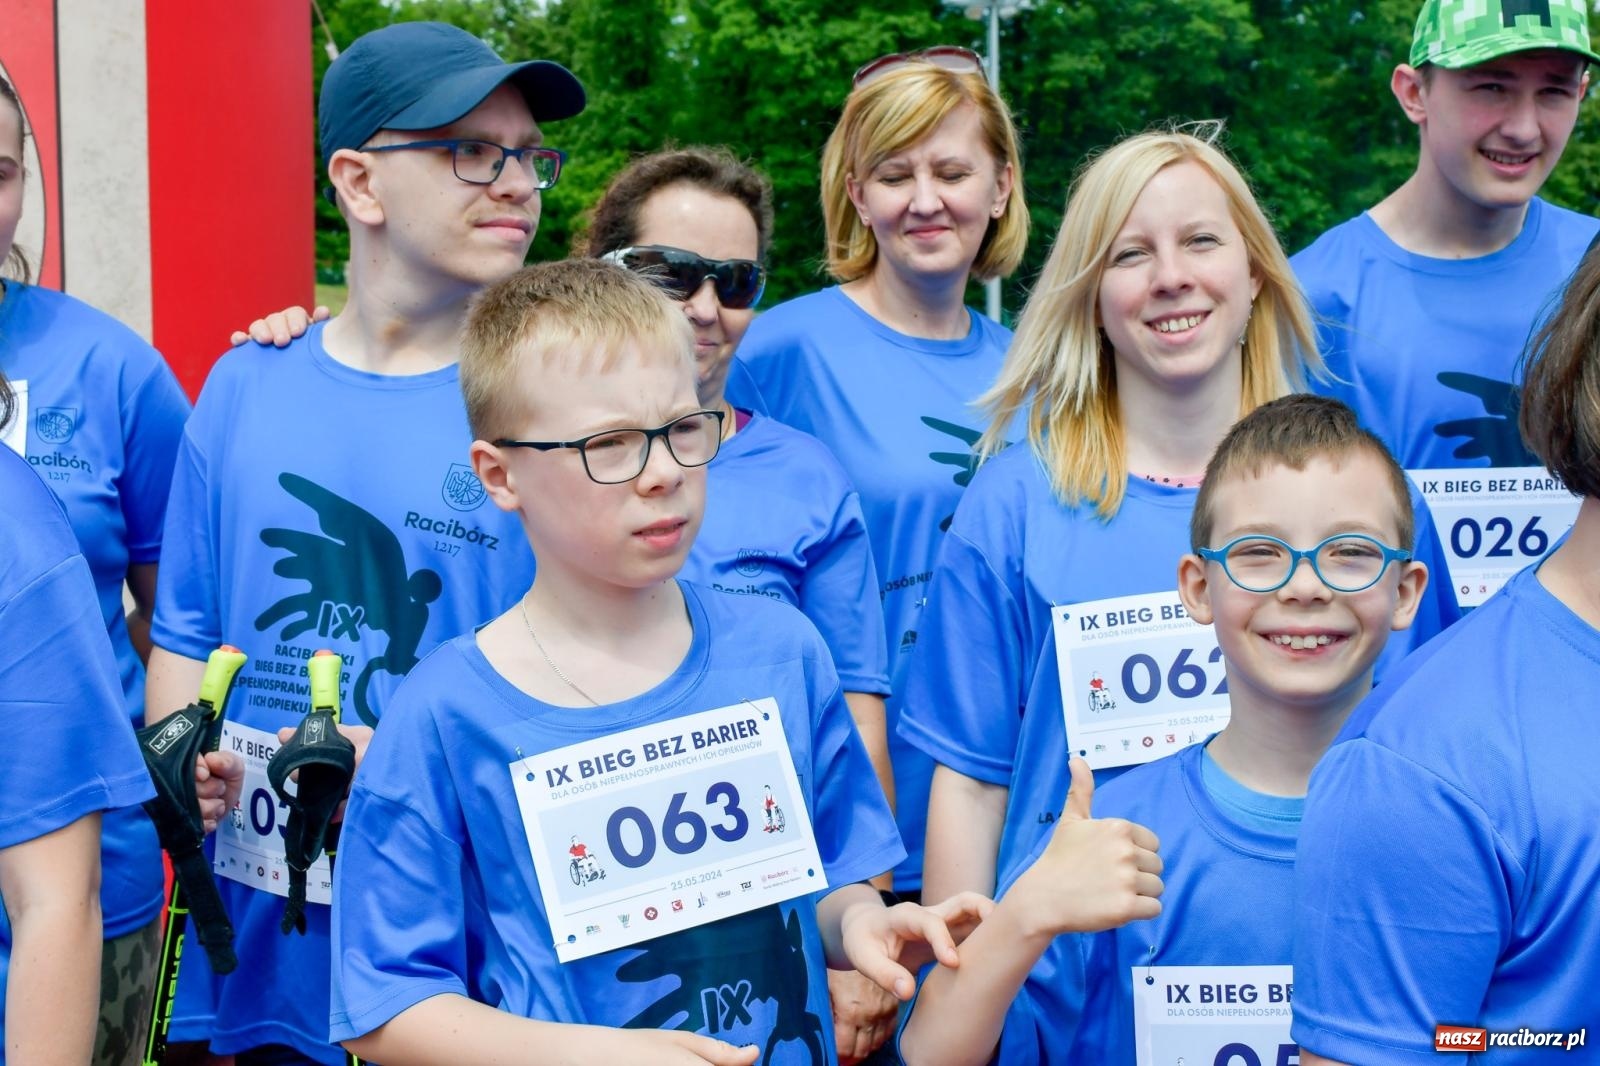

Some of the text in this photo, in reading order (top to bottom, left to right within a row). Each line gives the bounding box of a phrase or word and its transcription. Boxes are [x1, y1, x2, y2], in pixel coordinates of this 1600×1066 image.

[48, 472, 71, 484] 1217
[1423, 481, 1439, 493] IX
[1445, 480, 1482, 493] BIEG
[1488, 479, 1518, 492] BEZ
[404, 511, 500, 551] Racibórz
[1450, 516, 1549, 559] 026
[434, 541, 461, 558] 1217
[318, 600, 365, 642] IX
[1080, 603, 1191, 631] IX BIEG BE
[255, 660, 274, 673] BIEG
[275, 662, 297, 677] BEZ
[253, 695, 266, 708] ICH
[232, 735, 243, 753] IX
[247, 740, 275, 761] BIEG
[546, 718, 760, 788] IX BIEG BEZ BARIER
[551, 788, 571, 800] DLA
[571, 780, 599, 795] OSÓB
[599, 755, 699, 788] NIEPEŁNOSPRAWNYCH
[606, 781, 749, 869] 063
[670, 869, 723, 891] 25.05.2024
[700, 979, 753, 1034] IX
[1166, 984, 1191, 1004] IX
[1199, 983, 1258, 1004] BIEG
[1167, 1008, 1185, 1017] DLA
[1187, 1005, 1215, 1017] OSÓB
